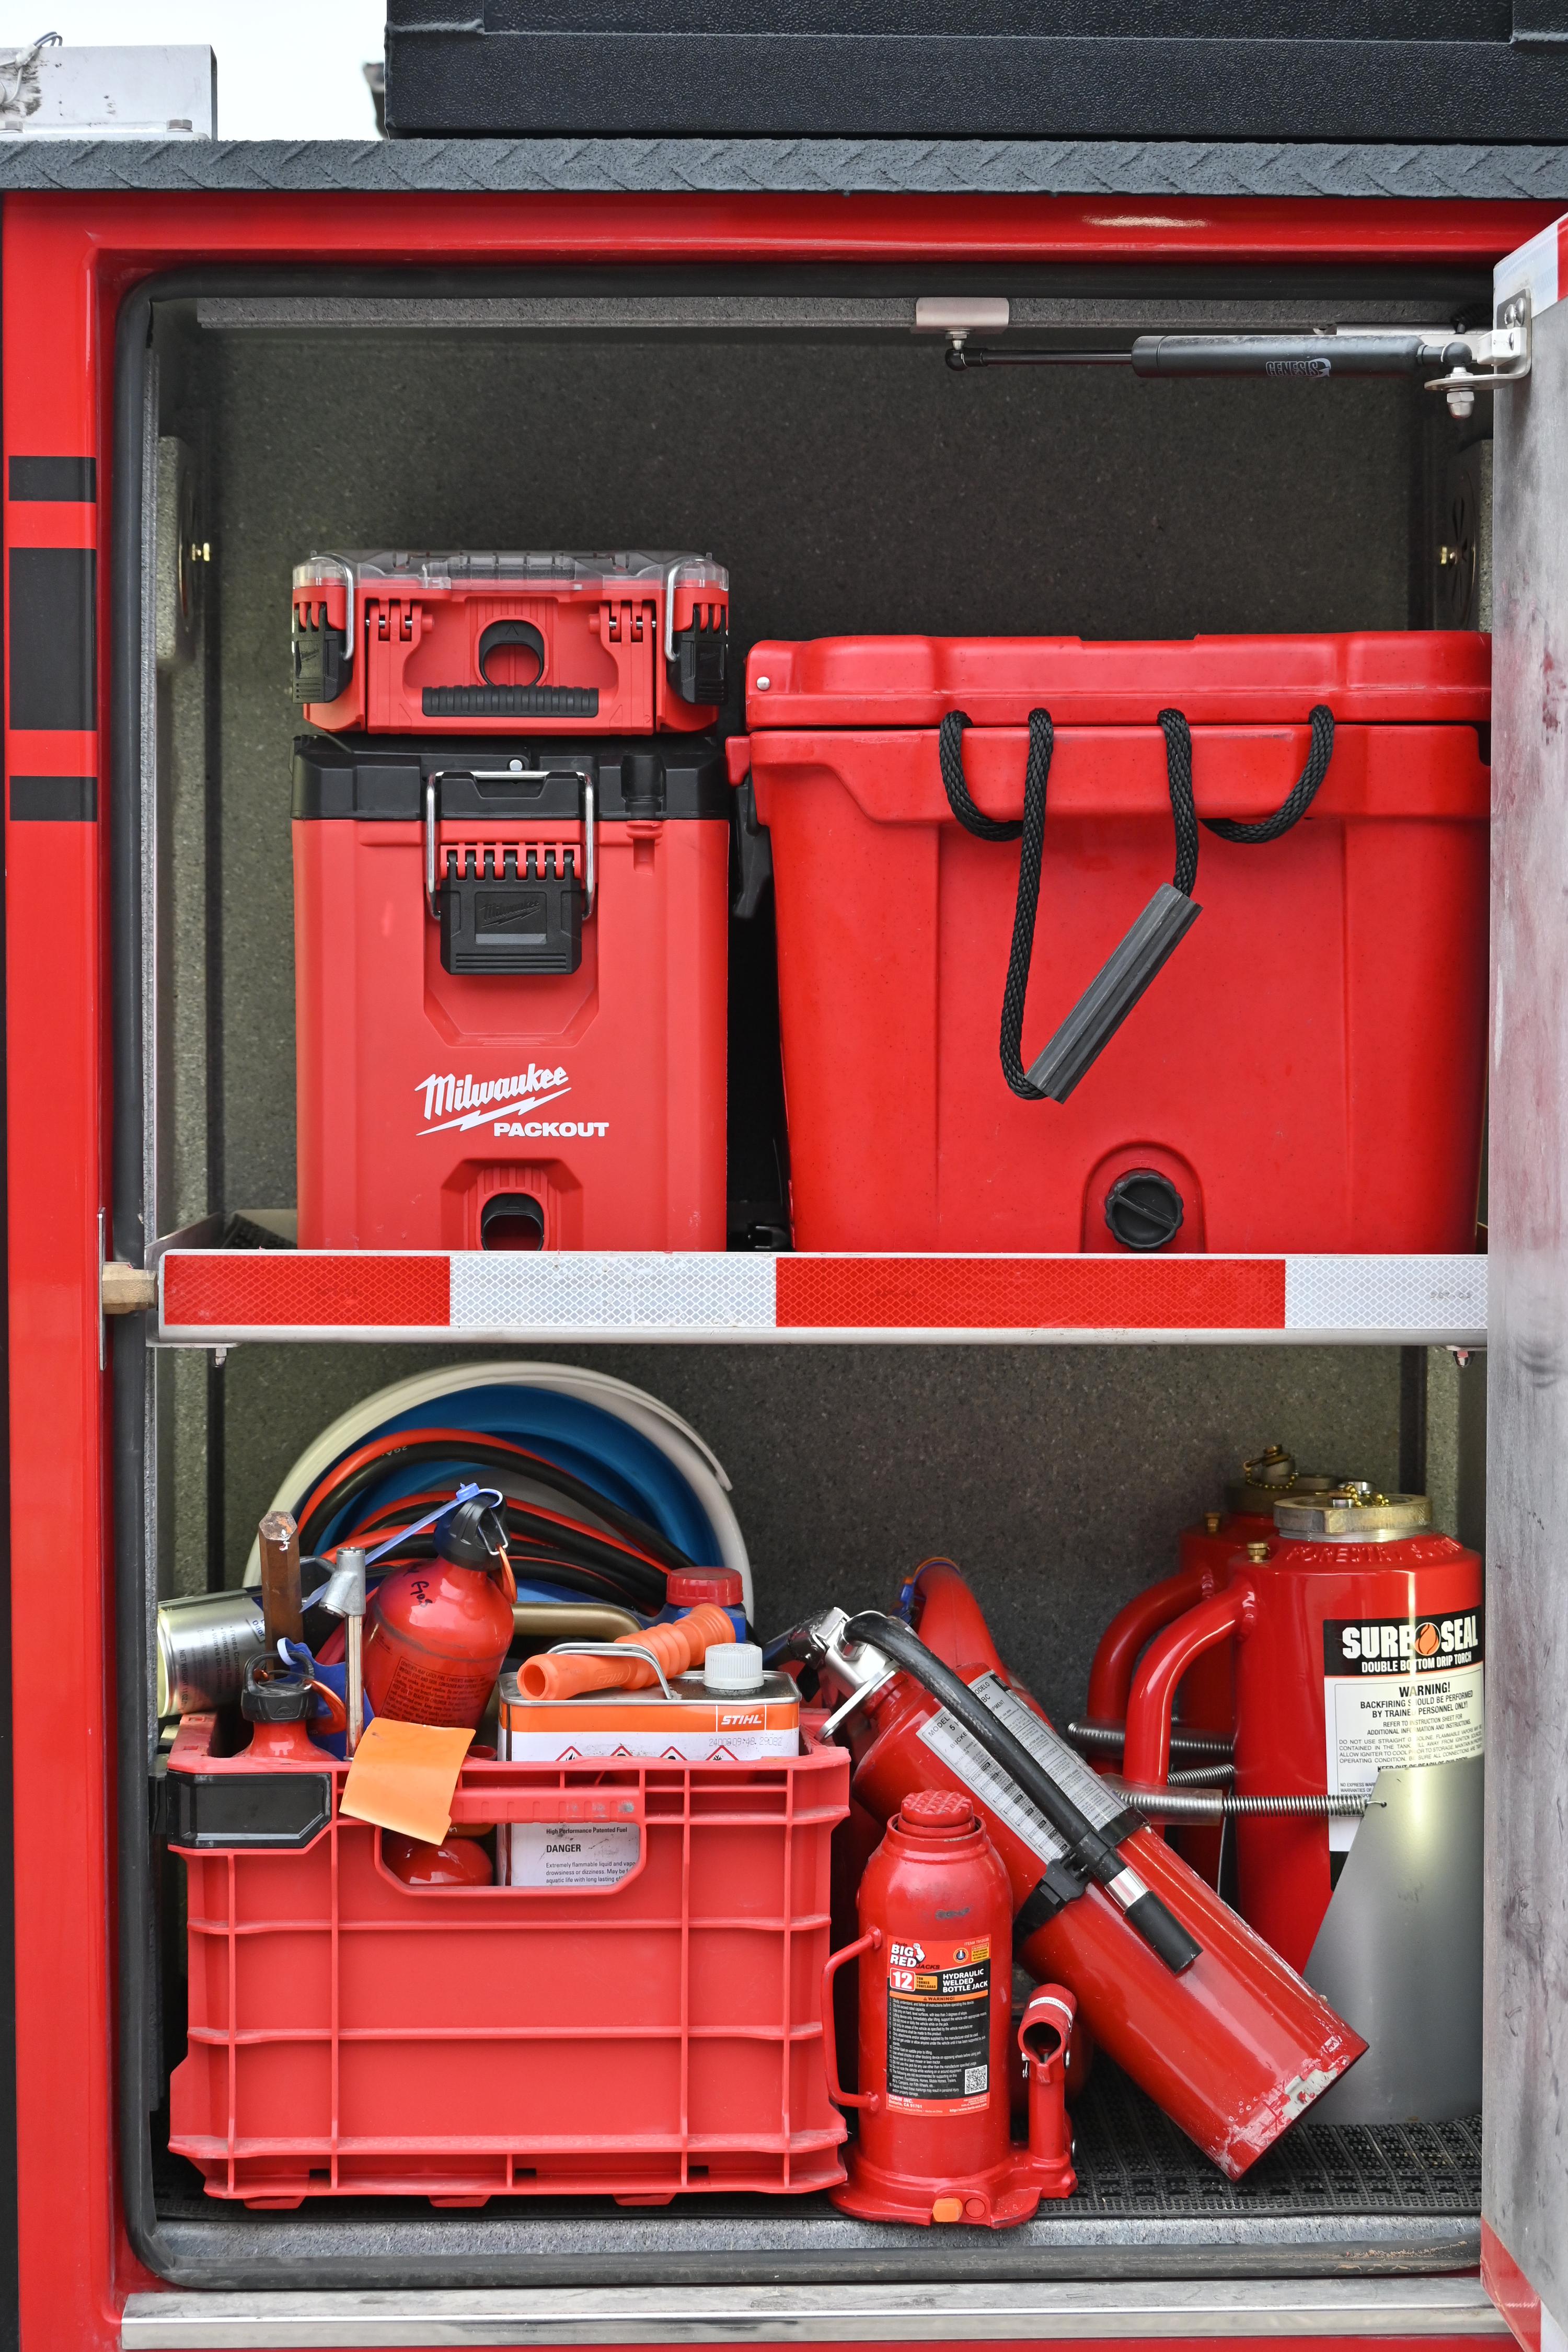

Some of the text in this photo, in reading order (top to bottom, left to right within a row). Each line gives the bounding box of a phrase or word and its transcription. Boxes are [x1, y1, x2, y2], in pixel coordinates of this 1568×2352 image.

[1266, 361, 1320, 377] GENESIS
[414, 1063, 569, 1120] Milwaukee
[494, 1122, 609, 1137] PACKOUT
[1342, 1615, 1478, 1659] SURE SEAL
[212, 1633, 220, 1656] Works
[216, 1657, 222, 1668] On
[222, 1631, 232, 1672] Penetrates
[1362, 1651, 1472, 1673] DOUBLE BOTTOM DRIP TORCH
[1399, 1681, 1450, 1697] WARNING!
[1361, 1700, 1405, 1709] BACKFIRING
[1436, 1695, 1444, 1703] BE
[1446, 1690, 1473, 1702] PERFORMED
[928, 1681, 990, 1737] MODEL ODELO
[1419, 1705, 1454, 1715] PERSONNEL
[1455, 1701, 1468, 1709] ONLY!
[721, 1714, 763, 1725] STIHL
[1410, 1717, 1440, 1725] INSTRUCTION
[1401, 1725, 1435, 1733] INFOMATION
[1443, 1747, 1469, 1757] CONNECTIONS
[546, 1844, 581, 1853] DANGER
[891, 1944, 914, 1957] BIG
[890, 1954, 917, 1967] RED
[893, 1971, 913, 1989] 12
[943, 1969, 984, 1980] HYDRAULIC
[942, 1978, 974, 1986] WELDED
[942, 1980, 988, 1993] BOTTLE JACK
